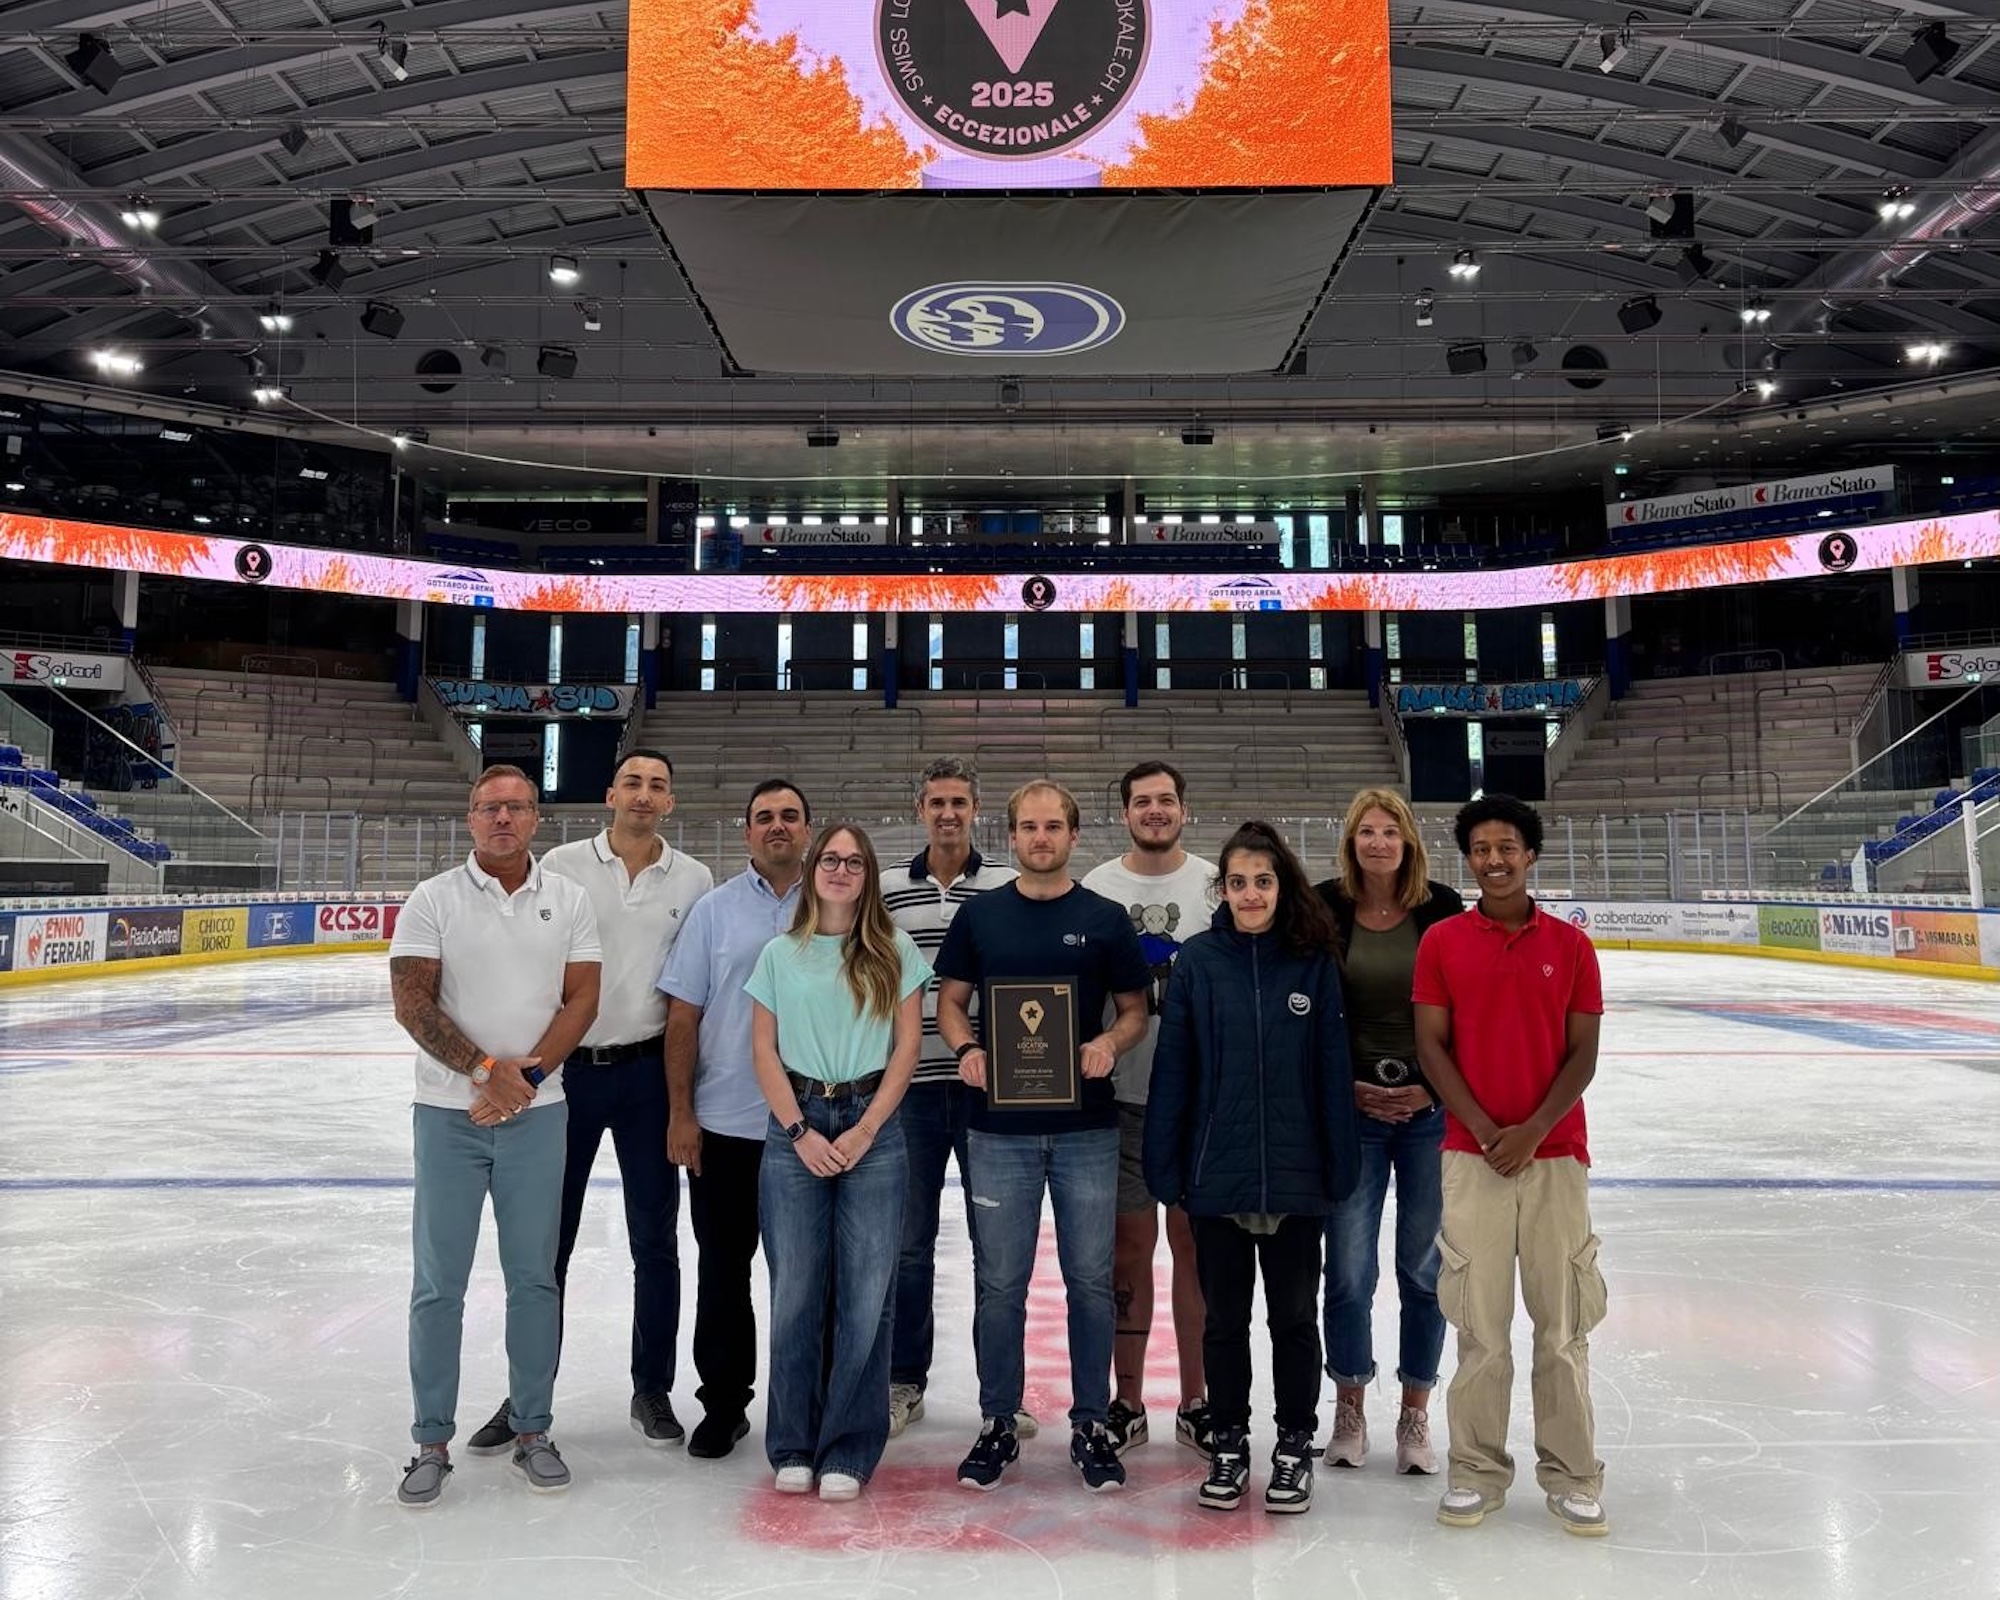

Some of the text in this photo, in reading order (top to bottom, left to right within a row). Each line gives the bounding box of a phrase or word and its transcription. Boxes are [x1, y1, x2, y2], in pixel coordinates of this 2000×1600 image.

[890, 28, 924, 92] SWISS
[971, 81, 1055, 107] 2025
[933, 103, 1093, 145] ECCEZIONALE
[1773, 476, 1876, 503] BancaStato
[1641, 495, 1736, 521] BancaStato
[779, 527, 871, 543] BancaStato
[1171, 525, 1264, 542] BancaStato
[427, 579, 494, 592] GOTTARDO ARENA
[1208, 589, 1281, 597] GOTTARDO ARENA
[27, 655, 102, 679] Solari
[436, 680, 620, 712] CURVA SUD
[45, 916, 85, 939] ENNIO
[199, 917, 236, 933] CHICCO
[320, 906, 379, 931] ecsa
[130, 924, 180, 946] RadioCentral
[352, 932, 378, 941] ENERGY
[1925, 931, 1963, 947] VISMARA
[1964, 933, 1976, 947] SA
[44, 940, 95, 965] FERRARI
[1016, 1041, 1049, 1050] LOCATION
